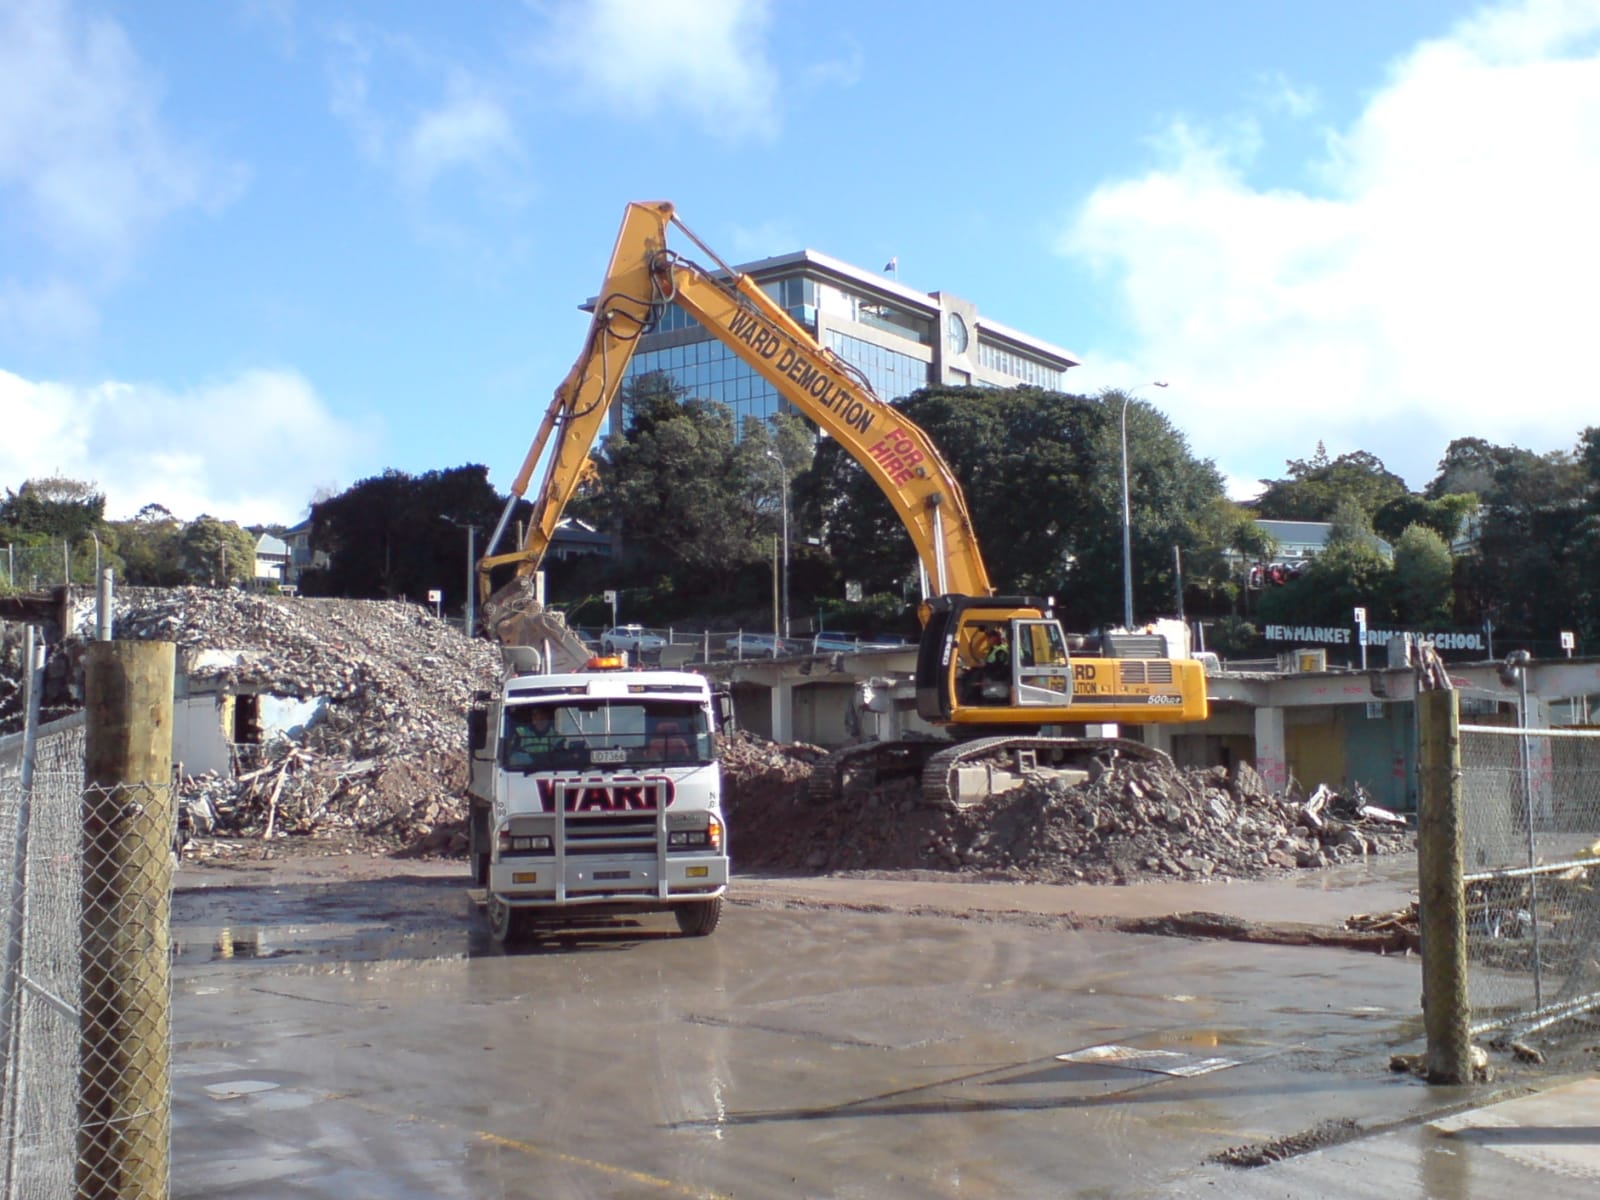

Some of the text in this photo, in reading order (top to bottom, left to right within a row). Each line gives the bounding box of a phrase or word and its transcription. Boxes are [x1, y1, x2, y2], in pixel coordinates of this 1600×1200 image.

[728, 308, 875, 434] WARD DEMOLITION
[867, 441, 915, 488] HIRE
[884, 427, 924, 468] FOR
[1265, 624, 1351, 644] NEWMARKET
[1426, 631, 1485, 650] SCHOOL
[535, 775, 676, 813] WARD
